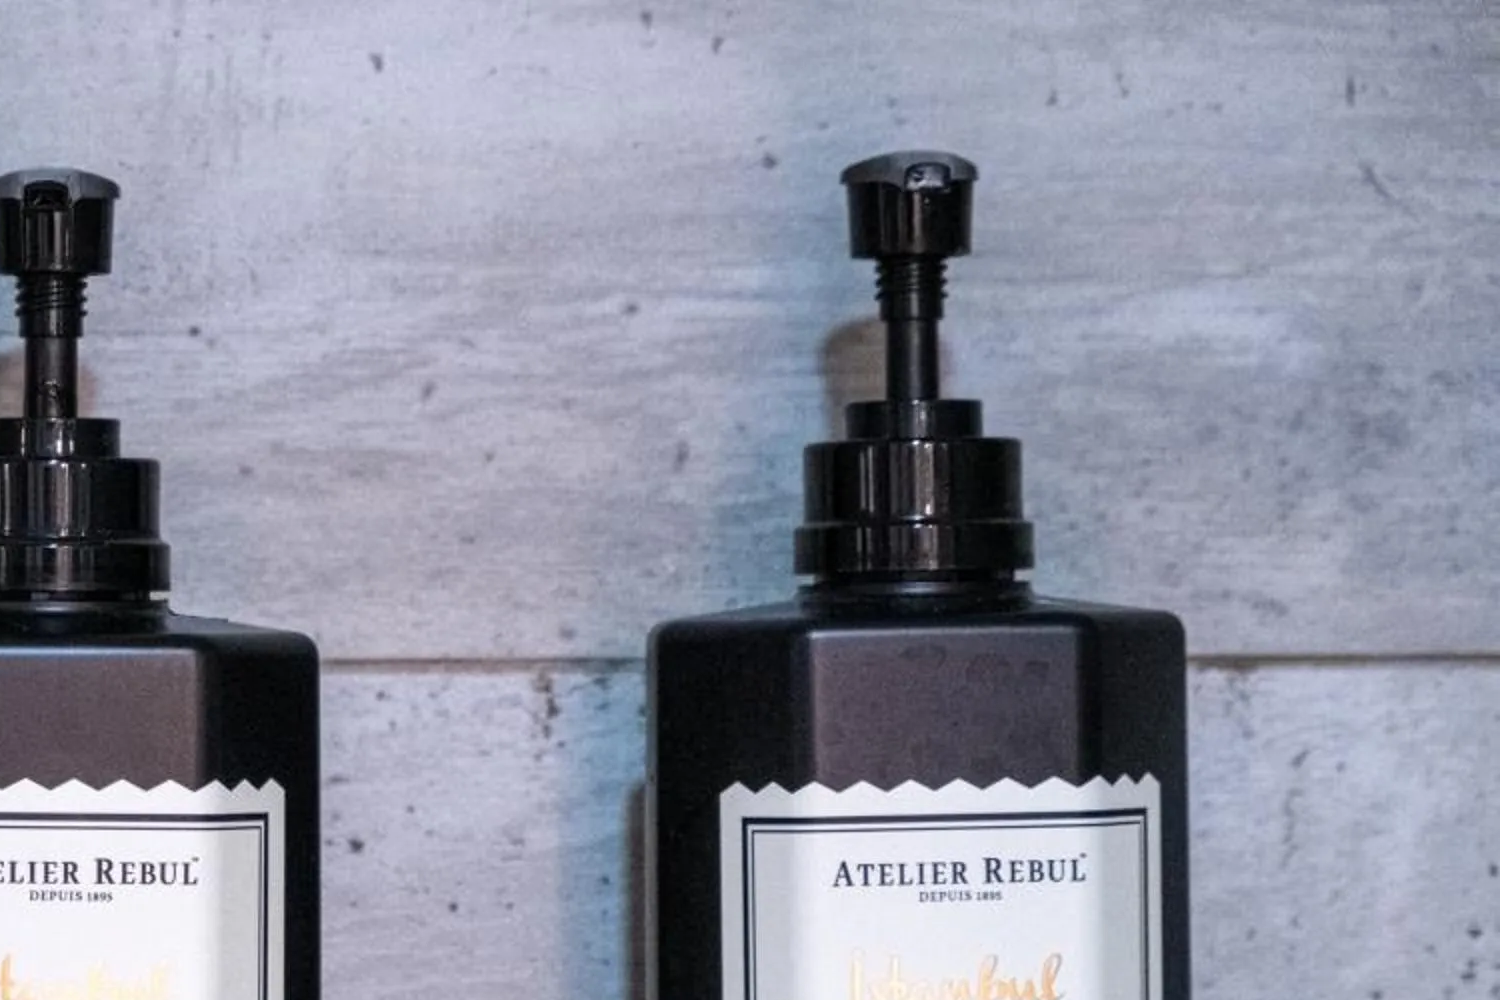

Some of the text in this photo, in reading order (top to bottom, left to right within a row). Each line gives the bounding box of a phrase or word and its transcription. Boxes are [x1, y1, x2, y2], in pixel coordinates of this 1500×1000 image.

[833, 861, 968, 887] ATELIER
[30, 890, 113, 902] DEPUIS 1895
[919, 890, 1002, 902] DEPUIS 1895
